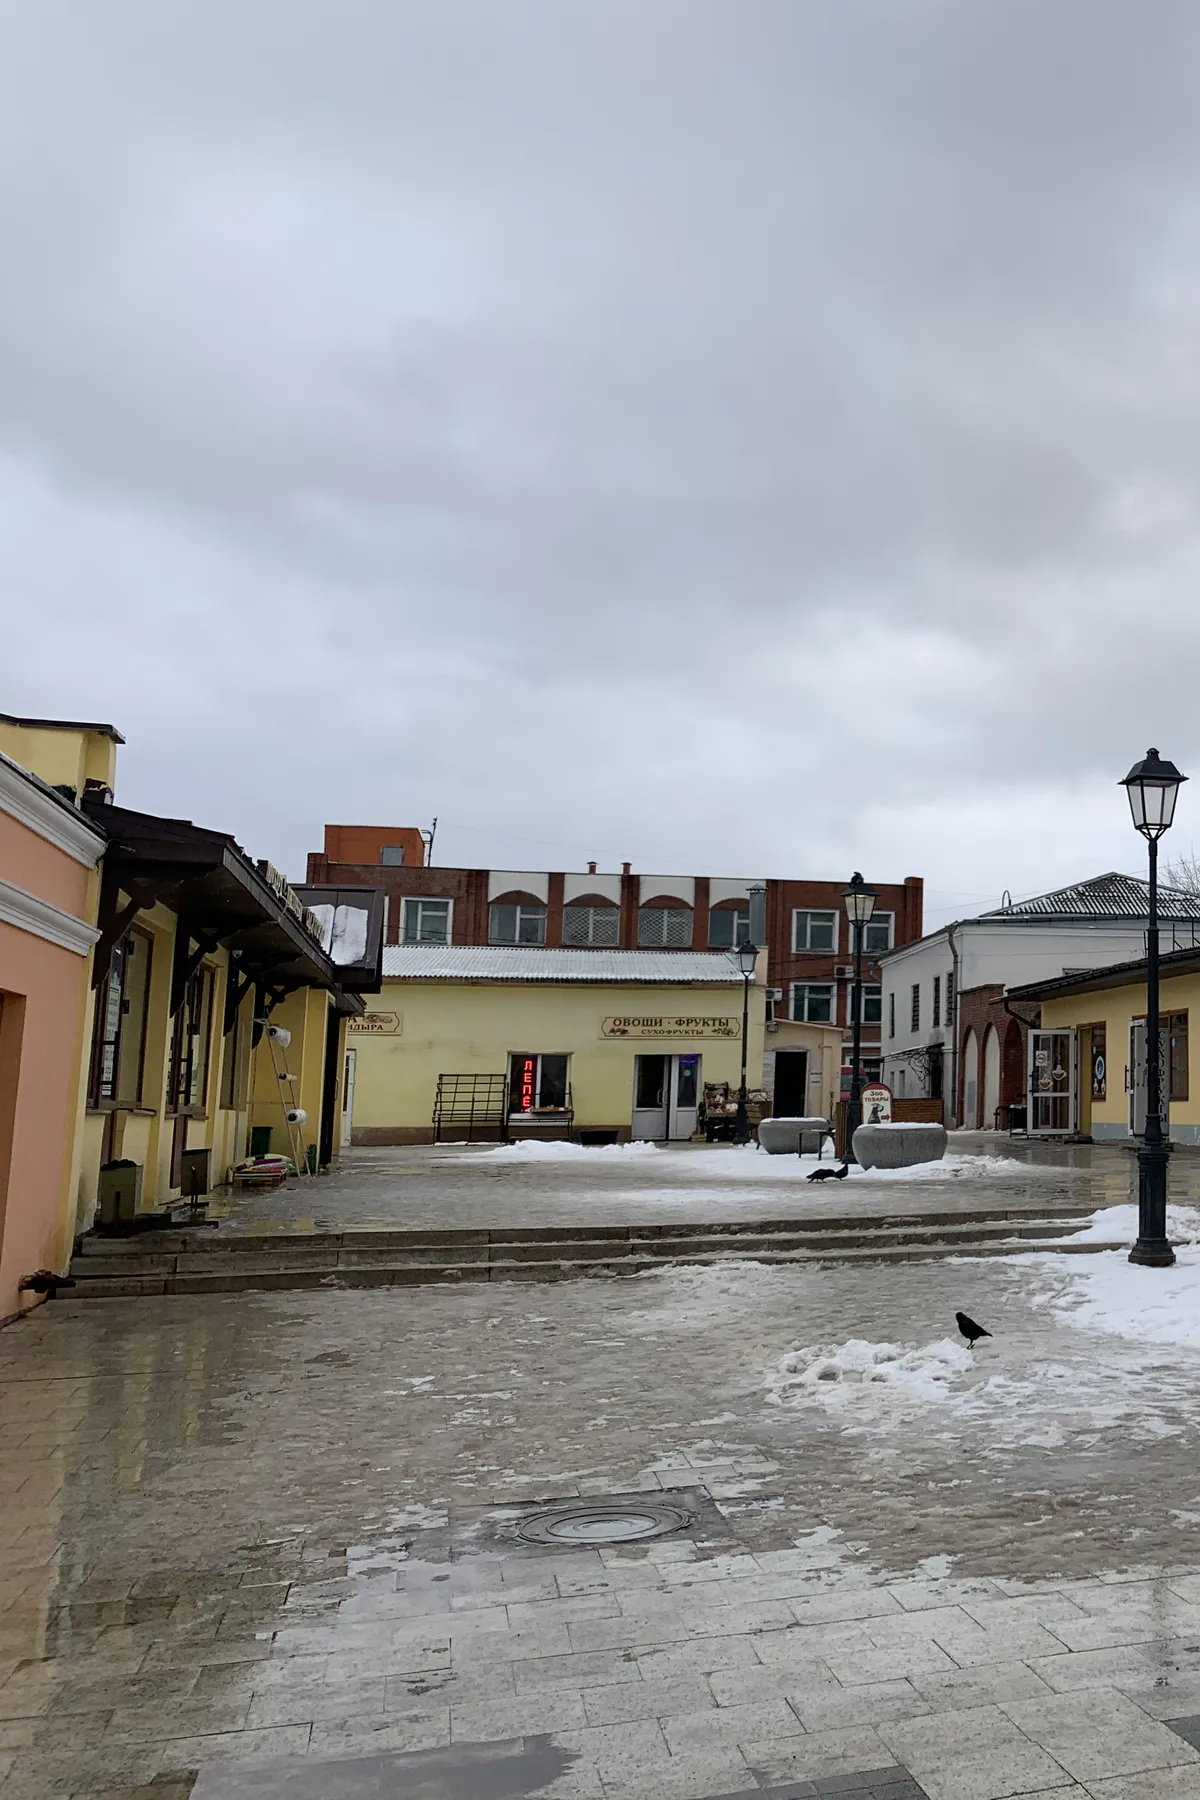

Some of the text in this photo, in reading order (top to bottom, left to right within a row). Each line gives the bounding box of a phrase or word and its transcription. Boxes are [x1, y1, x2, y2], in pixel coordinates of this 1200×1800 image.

[613, 1018, 729, 1027] ОВОЩИ ФРУКТЫ
[521, 1060, 533, 1112] ЛЕПЁ
